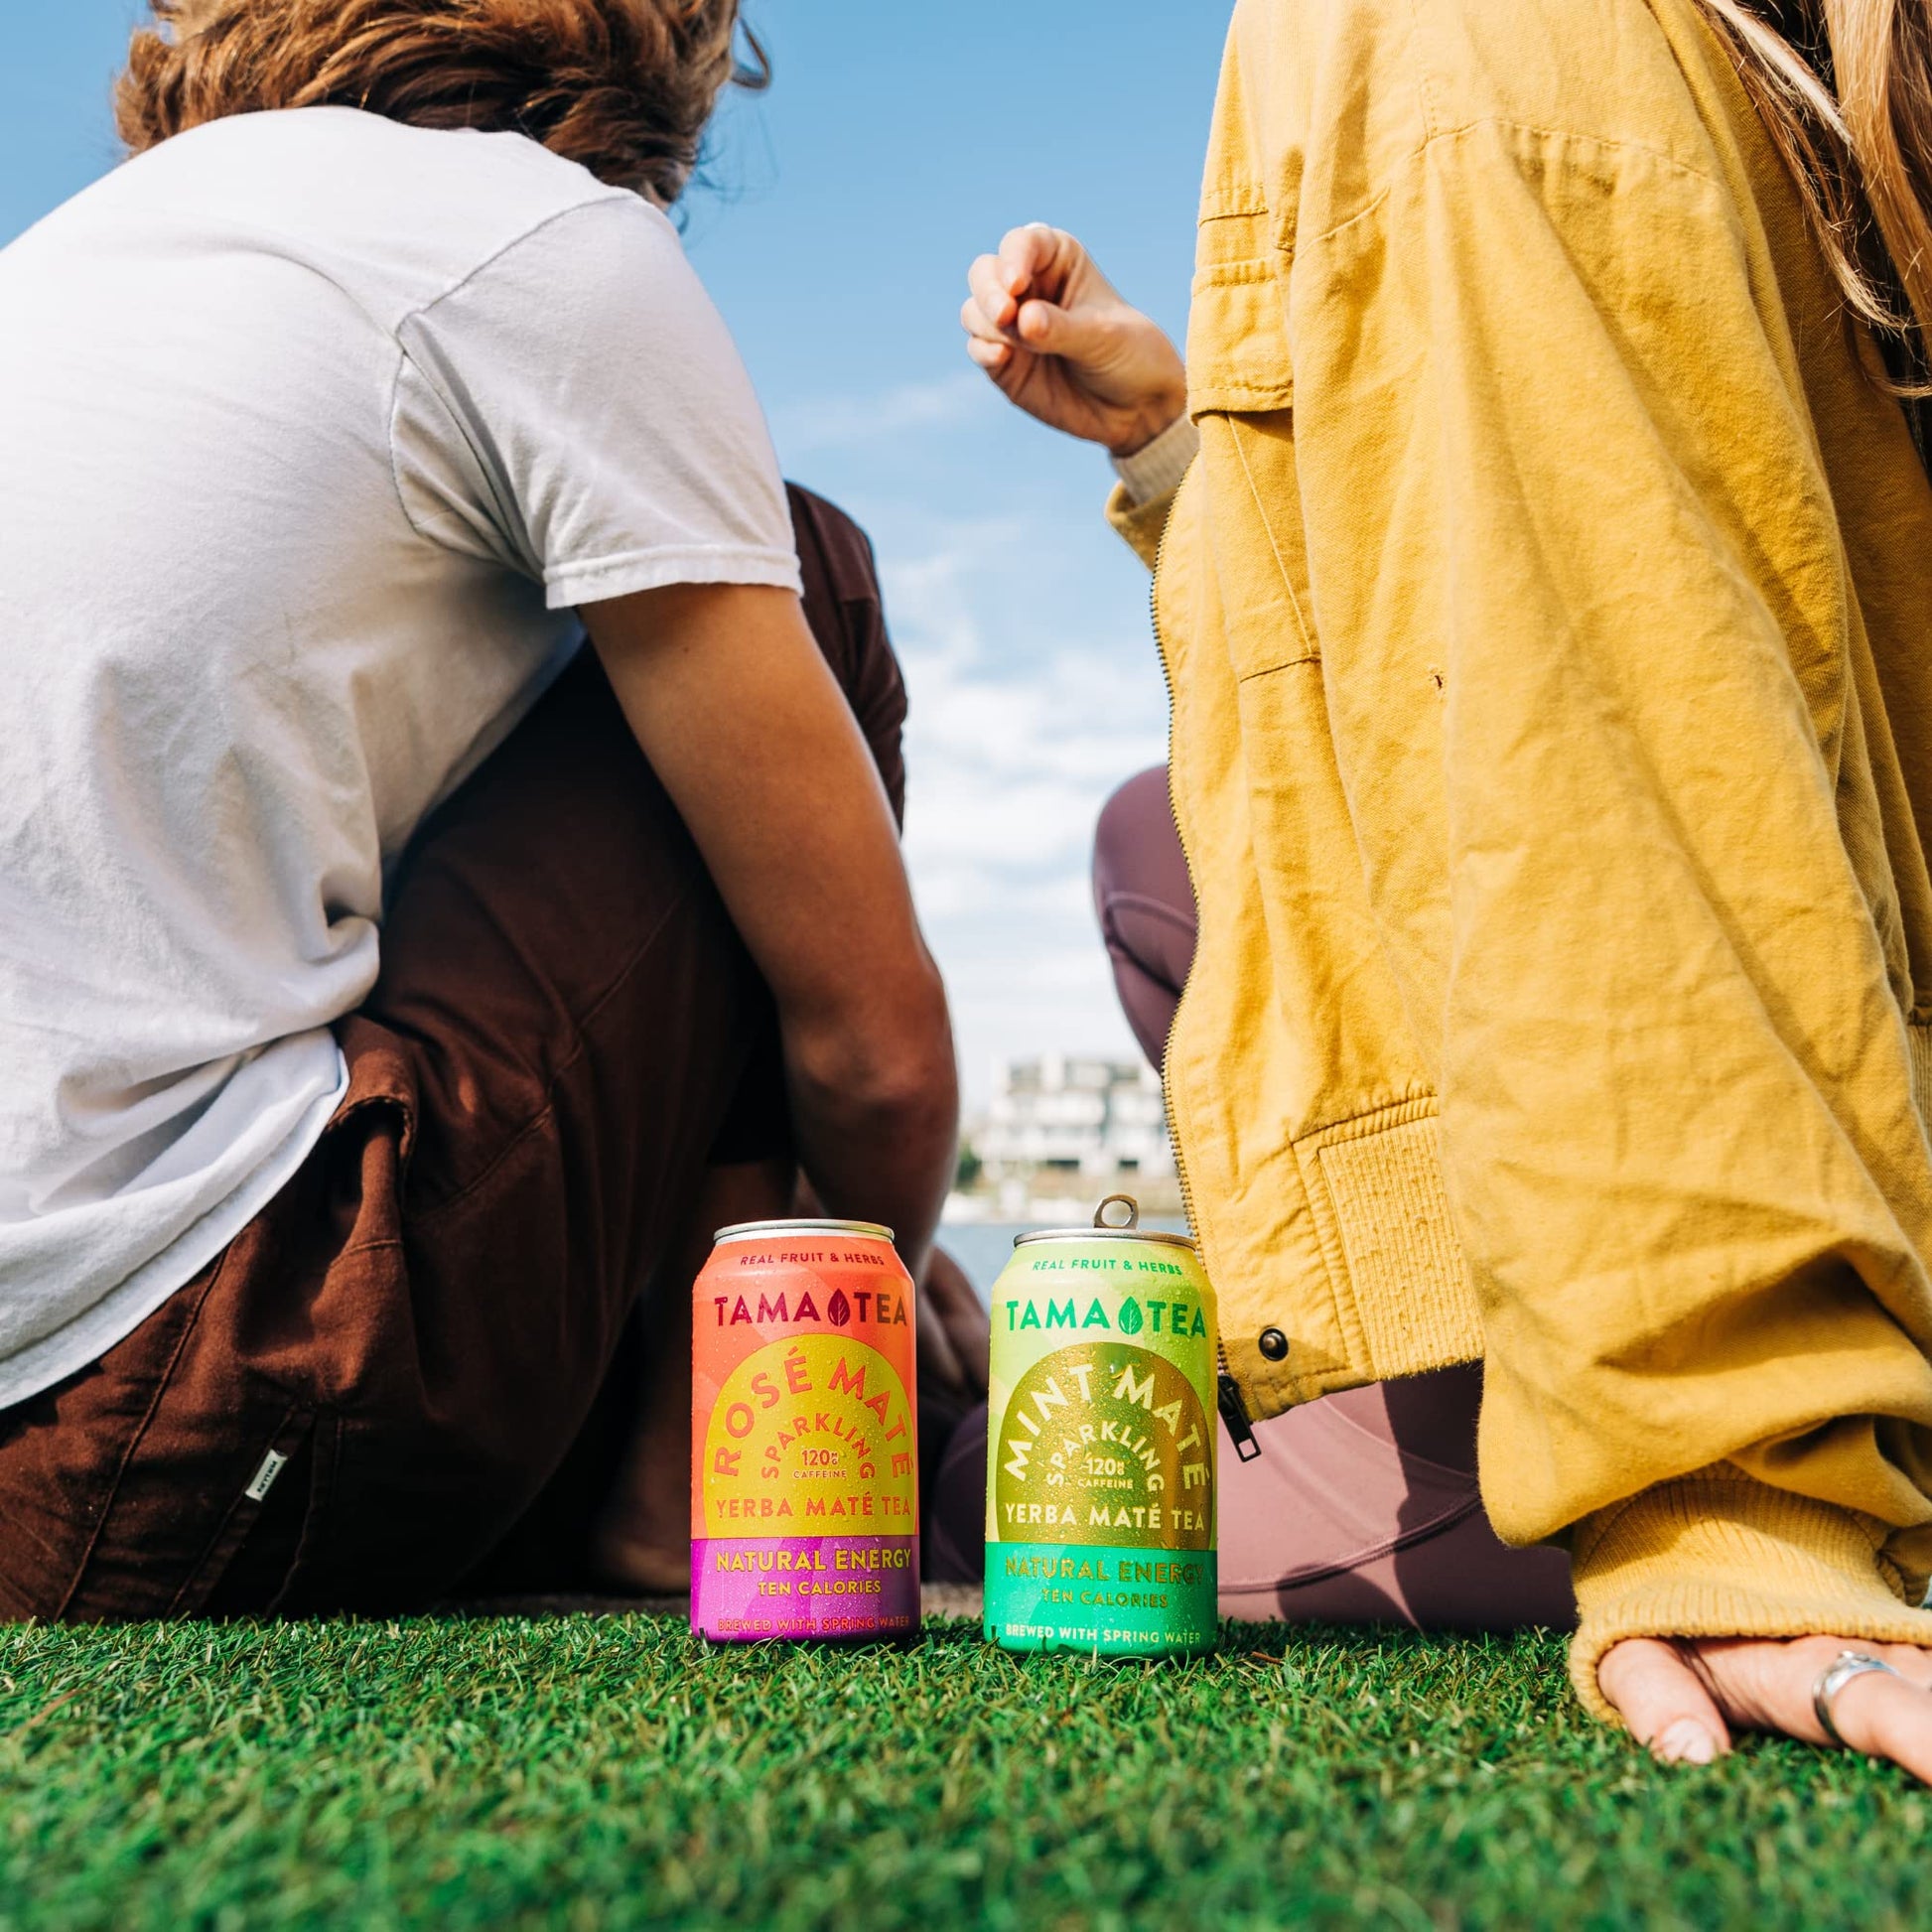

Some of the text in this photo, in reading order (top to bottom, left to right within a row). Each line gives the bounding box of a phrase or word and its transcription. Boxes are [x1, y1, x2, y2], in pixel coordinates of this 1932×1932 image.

[741, 1253, 885, 1266] REAL FRUIT & HERBS
[1032, 1260, 1182, 1275] REAL FRUIT & HERBS
[714, 1291, 907, 1327] TAMA TEA
[1006, 1298, 1206, 1338] TAMA TEA
[714, 1345, 813, 1477] ROSÉ
[1004, 1363, 1093, 1482] MINT
[760, 1413, 876, 1480] SPARKLING
[1046, 1420, 1165, 1492] SPARKLING
[793, 1469, 847, 1479] CAFFEINE
[1077, 1478, 1134, 1490] CAFFEINE
[716, 1491, 911, 1519] YERBA MATÉ TEA
[1005, 1502, 1205, 1532] YERBA MATÉ TEA
[716, 1548, 911, 1573] NATURAL ENERGY
[1005, 1555, 1204, 1584] NATURAL ENERGY
[759, 1579, 882, 1596] TEN CALORIES
[1042, 1587, 1169, 1608] TEN CALORIES
[718, 1614, 910, 1632] BREWED WITH SPRING WATER
[1005, 1622, 1201, 1645] BREWED WITH SPRING WATER
